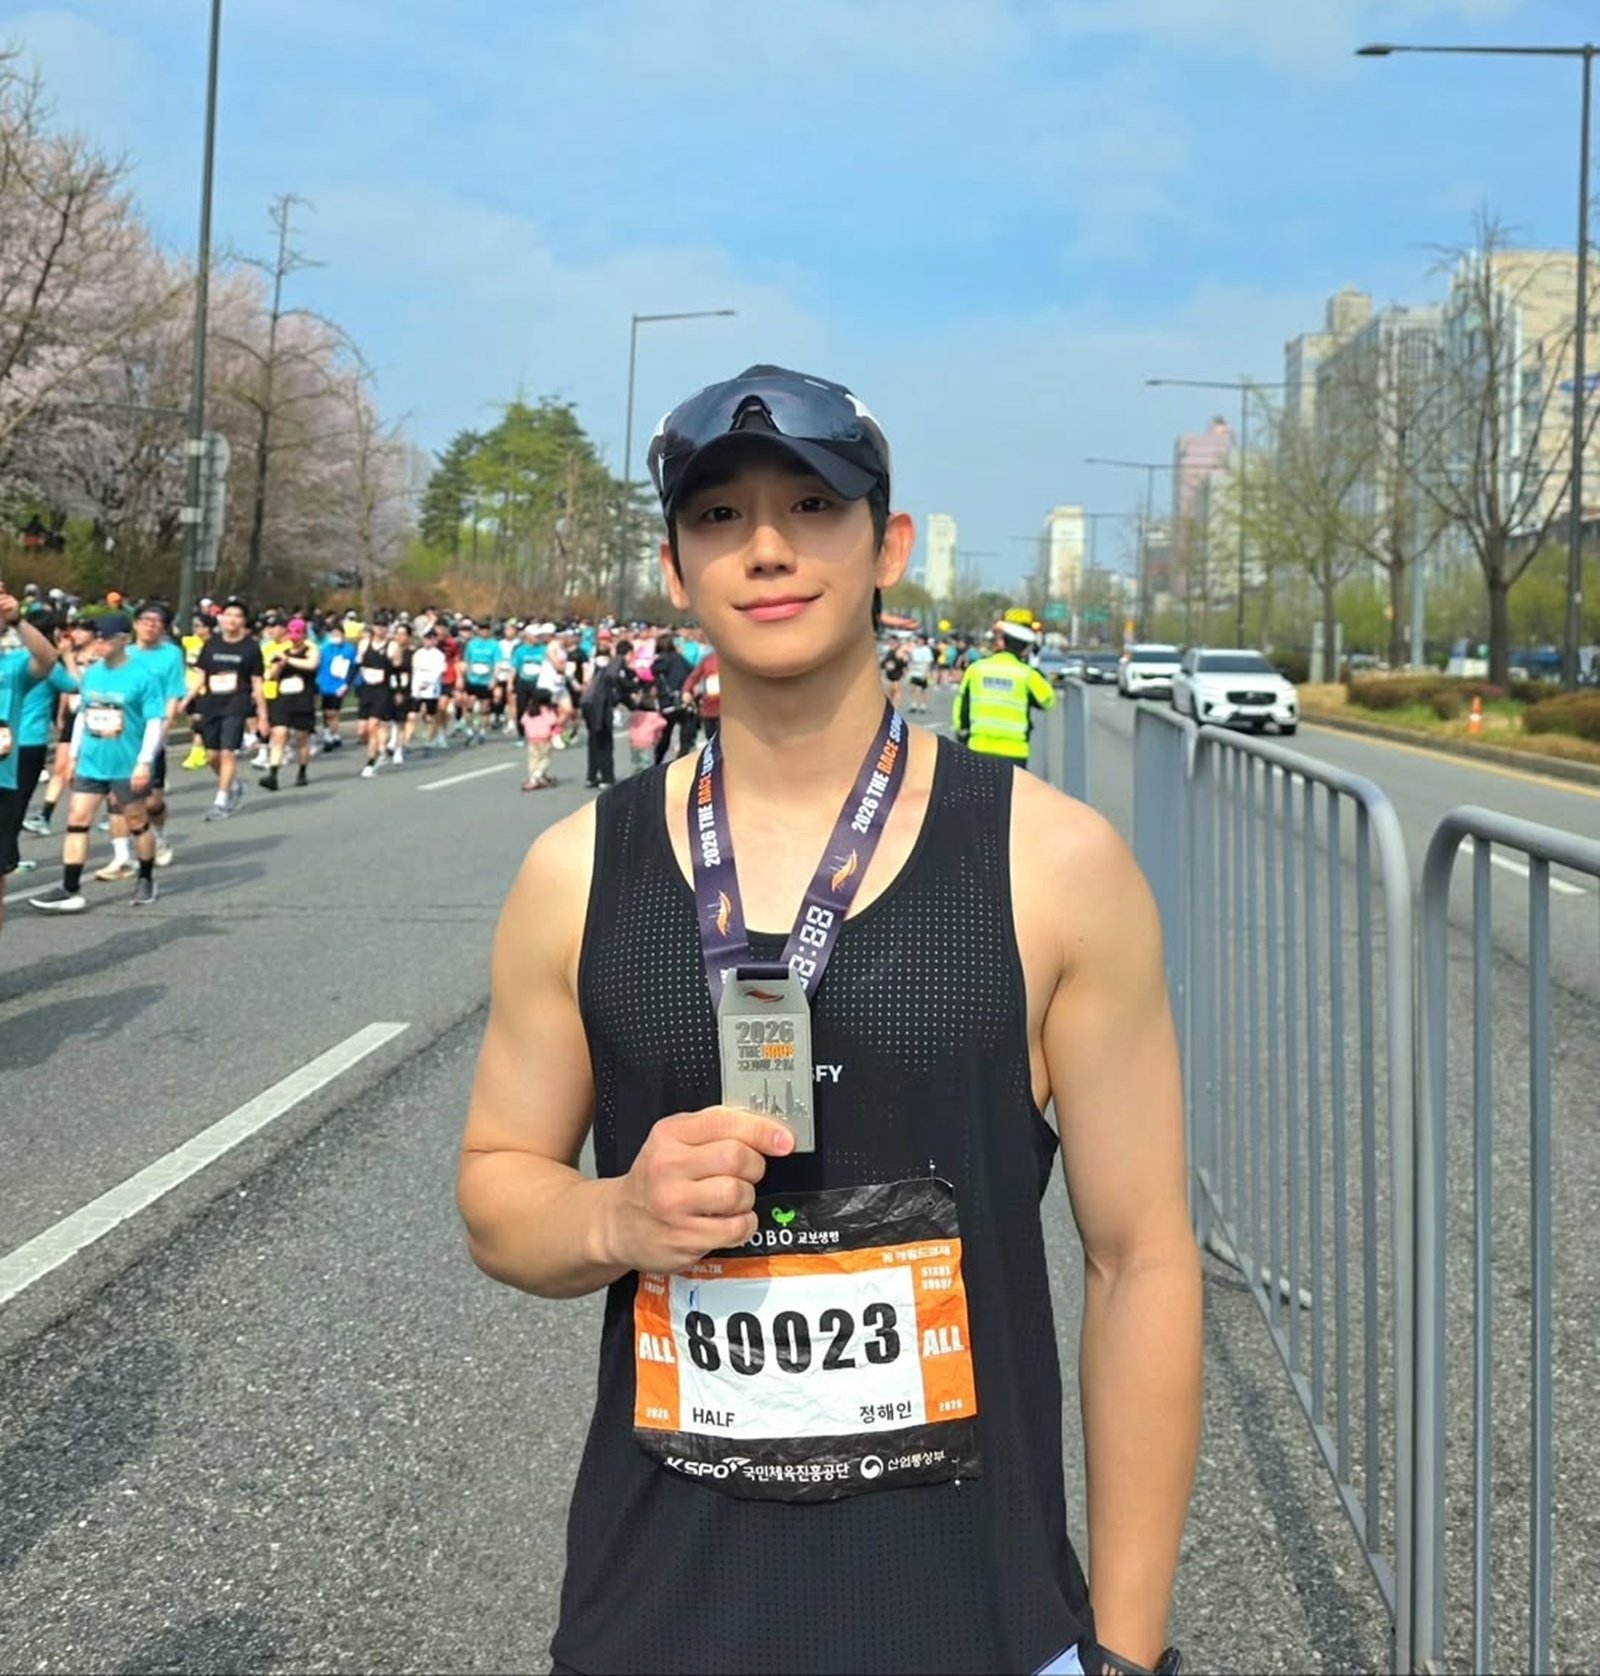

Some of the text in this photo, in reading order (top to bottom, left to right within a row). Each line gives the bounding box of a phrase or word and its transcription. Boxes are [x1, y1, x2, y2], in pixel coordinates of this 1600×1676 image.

[876, 739, 899, 775] RACE
[698, 773, 712, 805] RACE
[868, 771, 889, 798] THE
[698, 803, 714, 828] THE
[851, 796, 878, 834] 2026
[702, 829, 721, 868] 2026
[789, 905, 834, 991] 8:88
[735, 1020, 795, 1044] 2026
[797, 1230, 840, 1245] 교보생명
[638, 1332, 675, 1364] ALL
[685, 1302, 900, 1376] 80023
[923, 1325, 965, 1357] ALL
[693, 1407, 735, 1428] HALF
[860, 1400, 912, 1424] 정해인
[664, 1456, 730, 1479] KSPO
[742, 1462, 850, 1482] 국민체육진흥공단
[888, 1449, 946, 1471] 산업통상부
